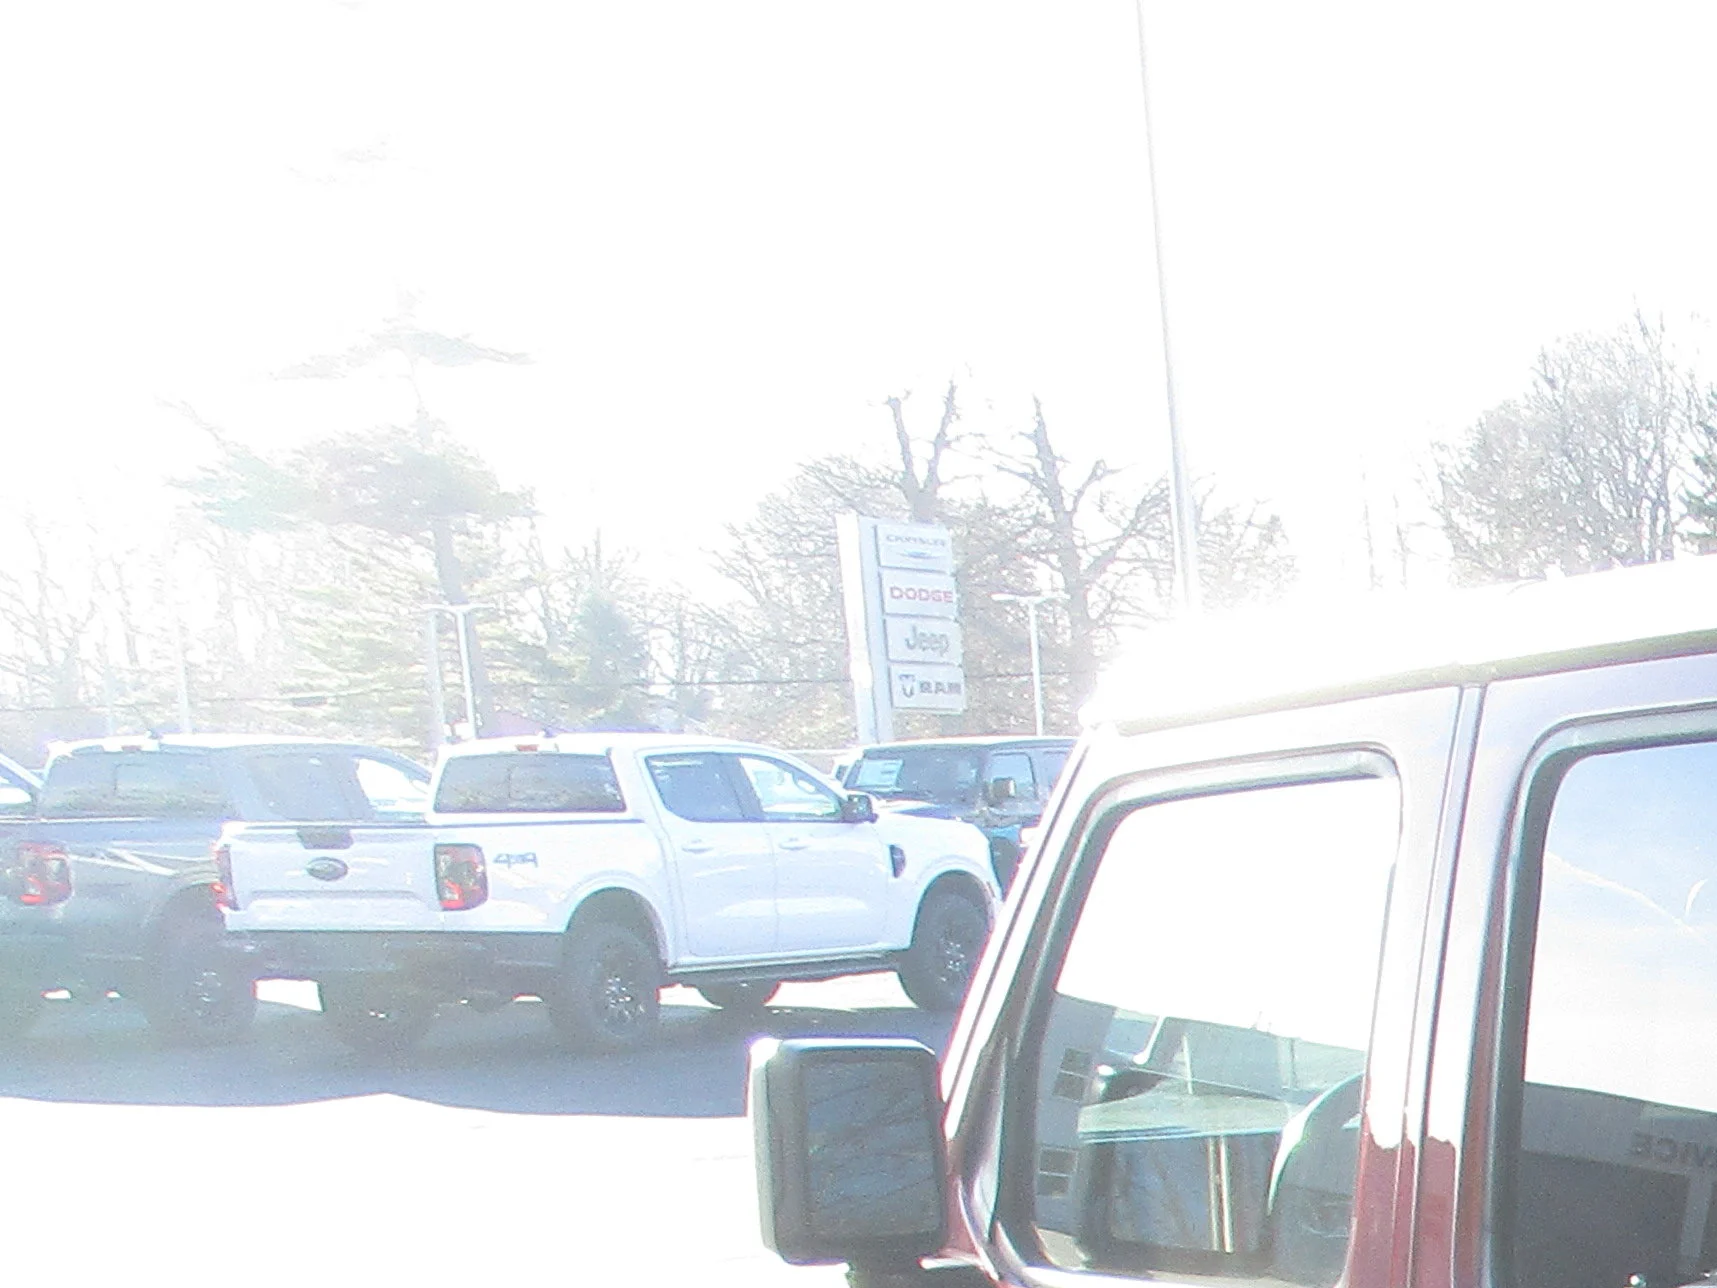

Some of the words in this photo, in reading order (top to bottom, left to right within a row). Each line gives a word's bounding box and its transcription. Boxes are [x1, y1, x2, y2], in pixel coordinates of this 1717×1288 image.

[890, 586, 954, 604] DODGE
[904, 625, 950, 656] Jeep
[920, 681, 962, 695] RAM
